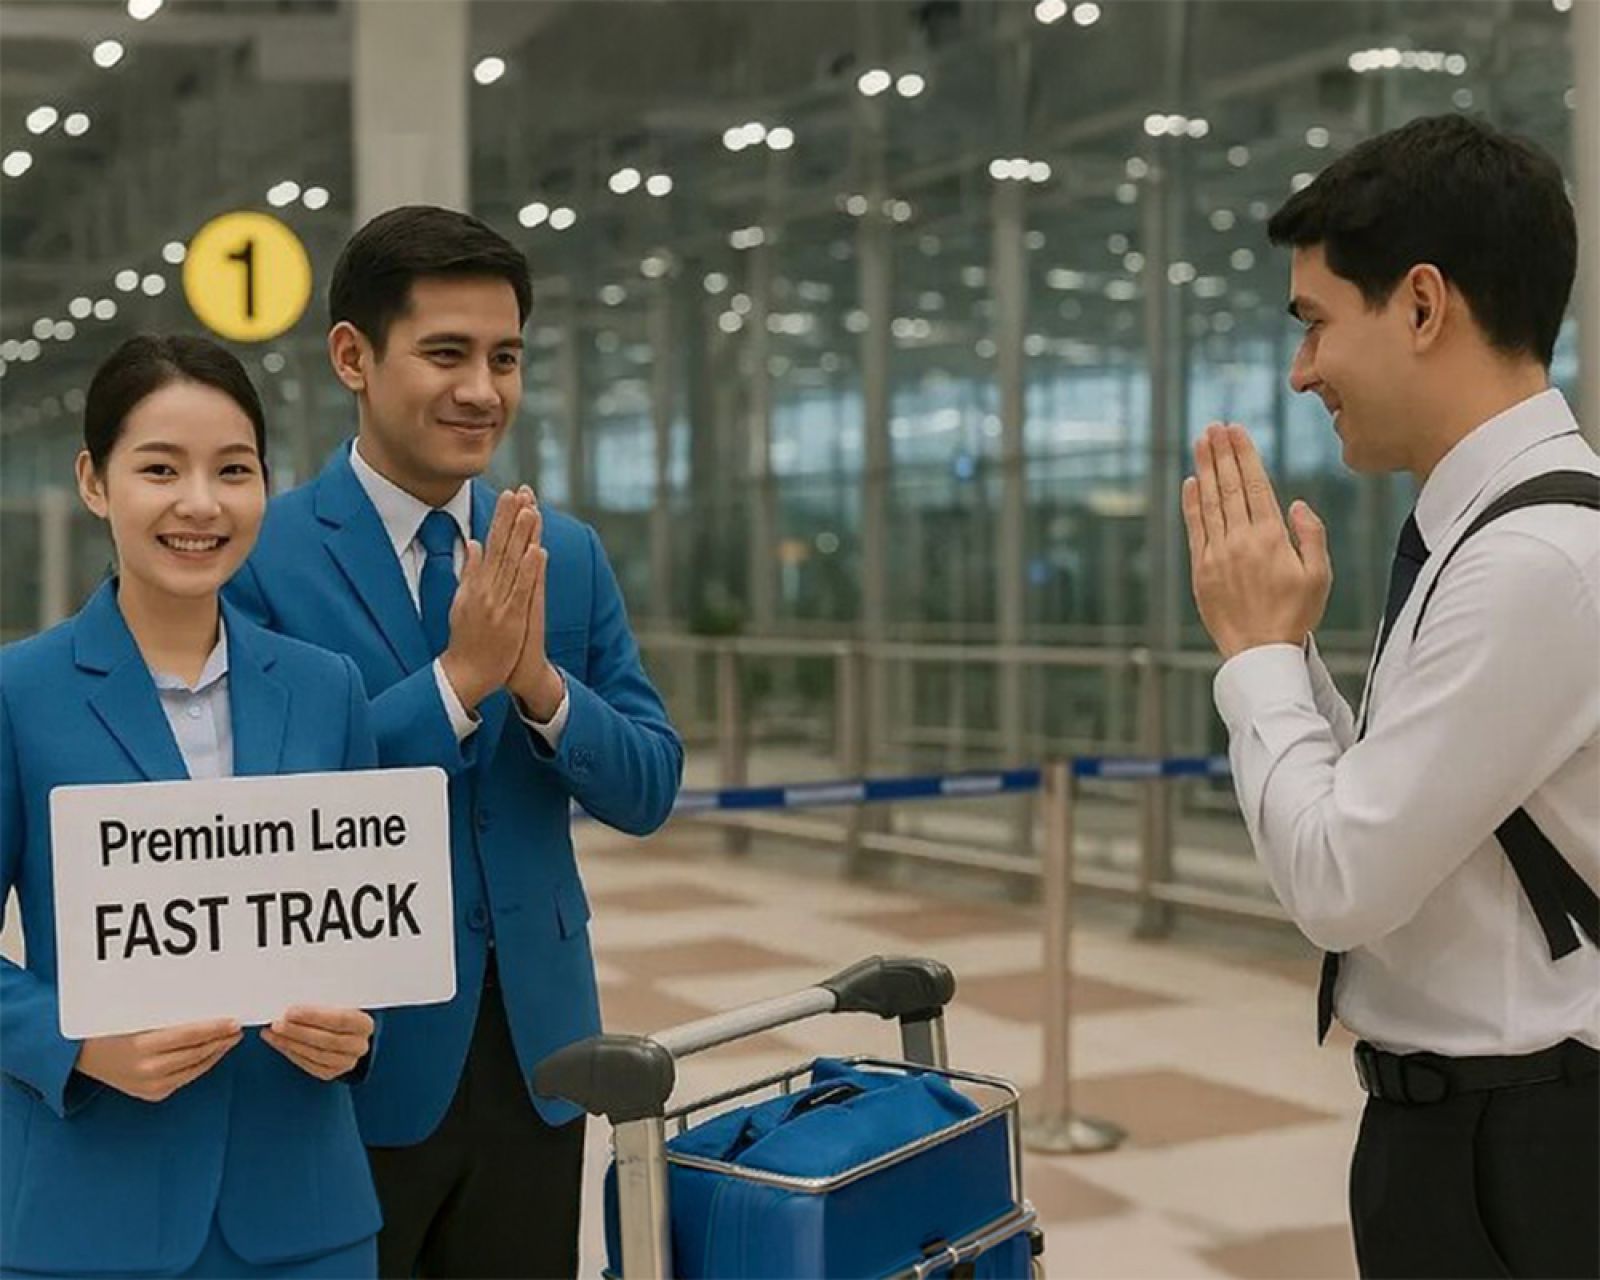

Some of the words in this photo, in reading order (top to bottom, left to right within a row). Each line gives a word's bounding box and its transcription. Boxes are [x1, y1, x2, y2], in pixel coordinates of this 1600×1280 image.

[226, 239, 255, 319] 1
[99, 813, 295, 867] Premium
[311, 807, 407, 852] Lane
[95, 895, 230, 961] FAST
[245, 881, 422, 948] TRACK
